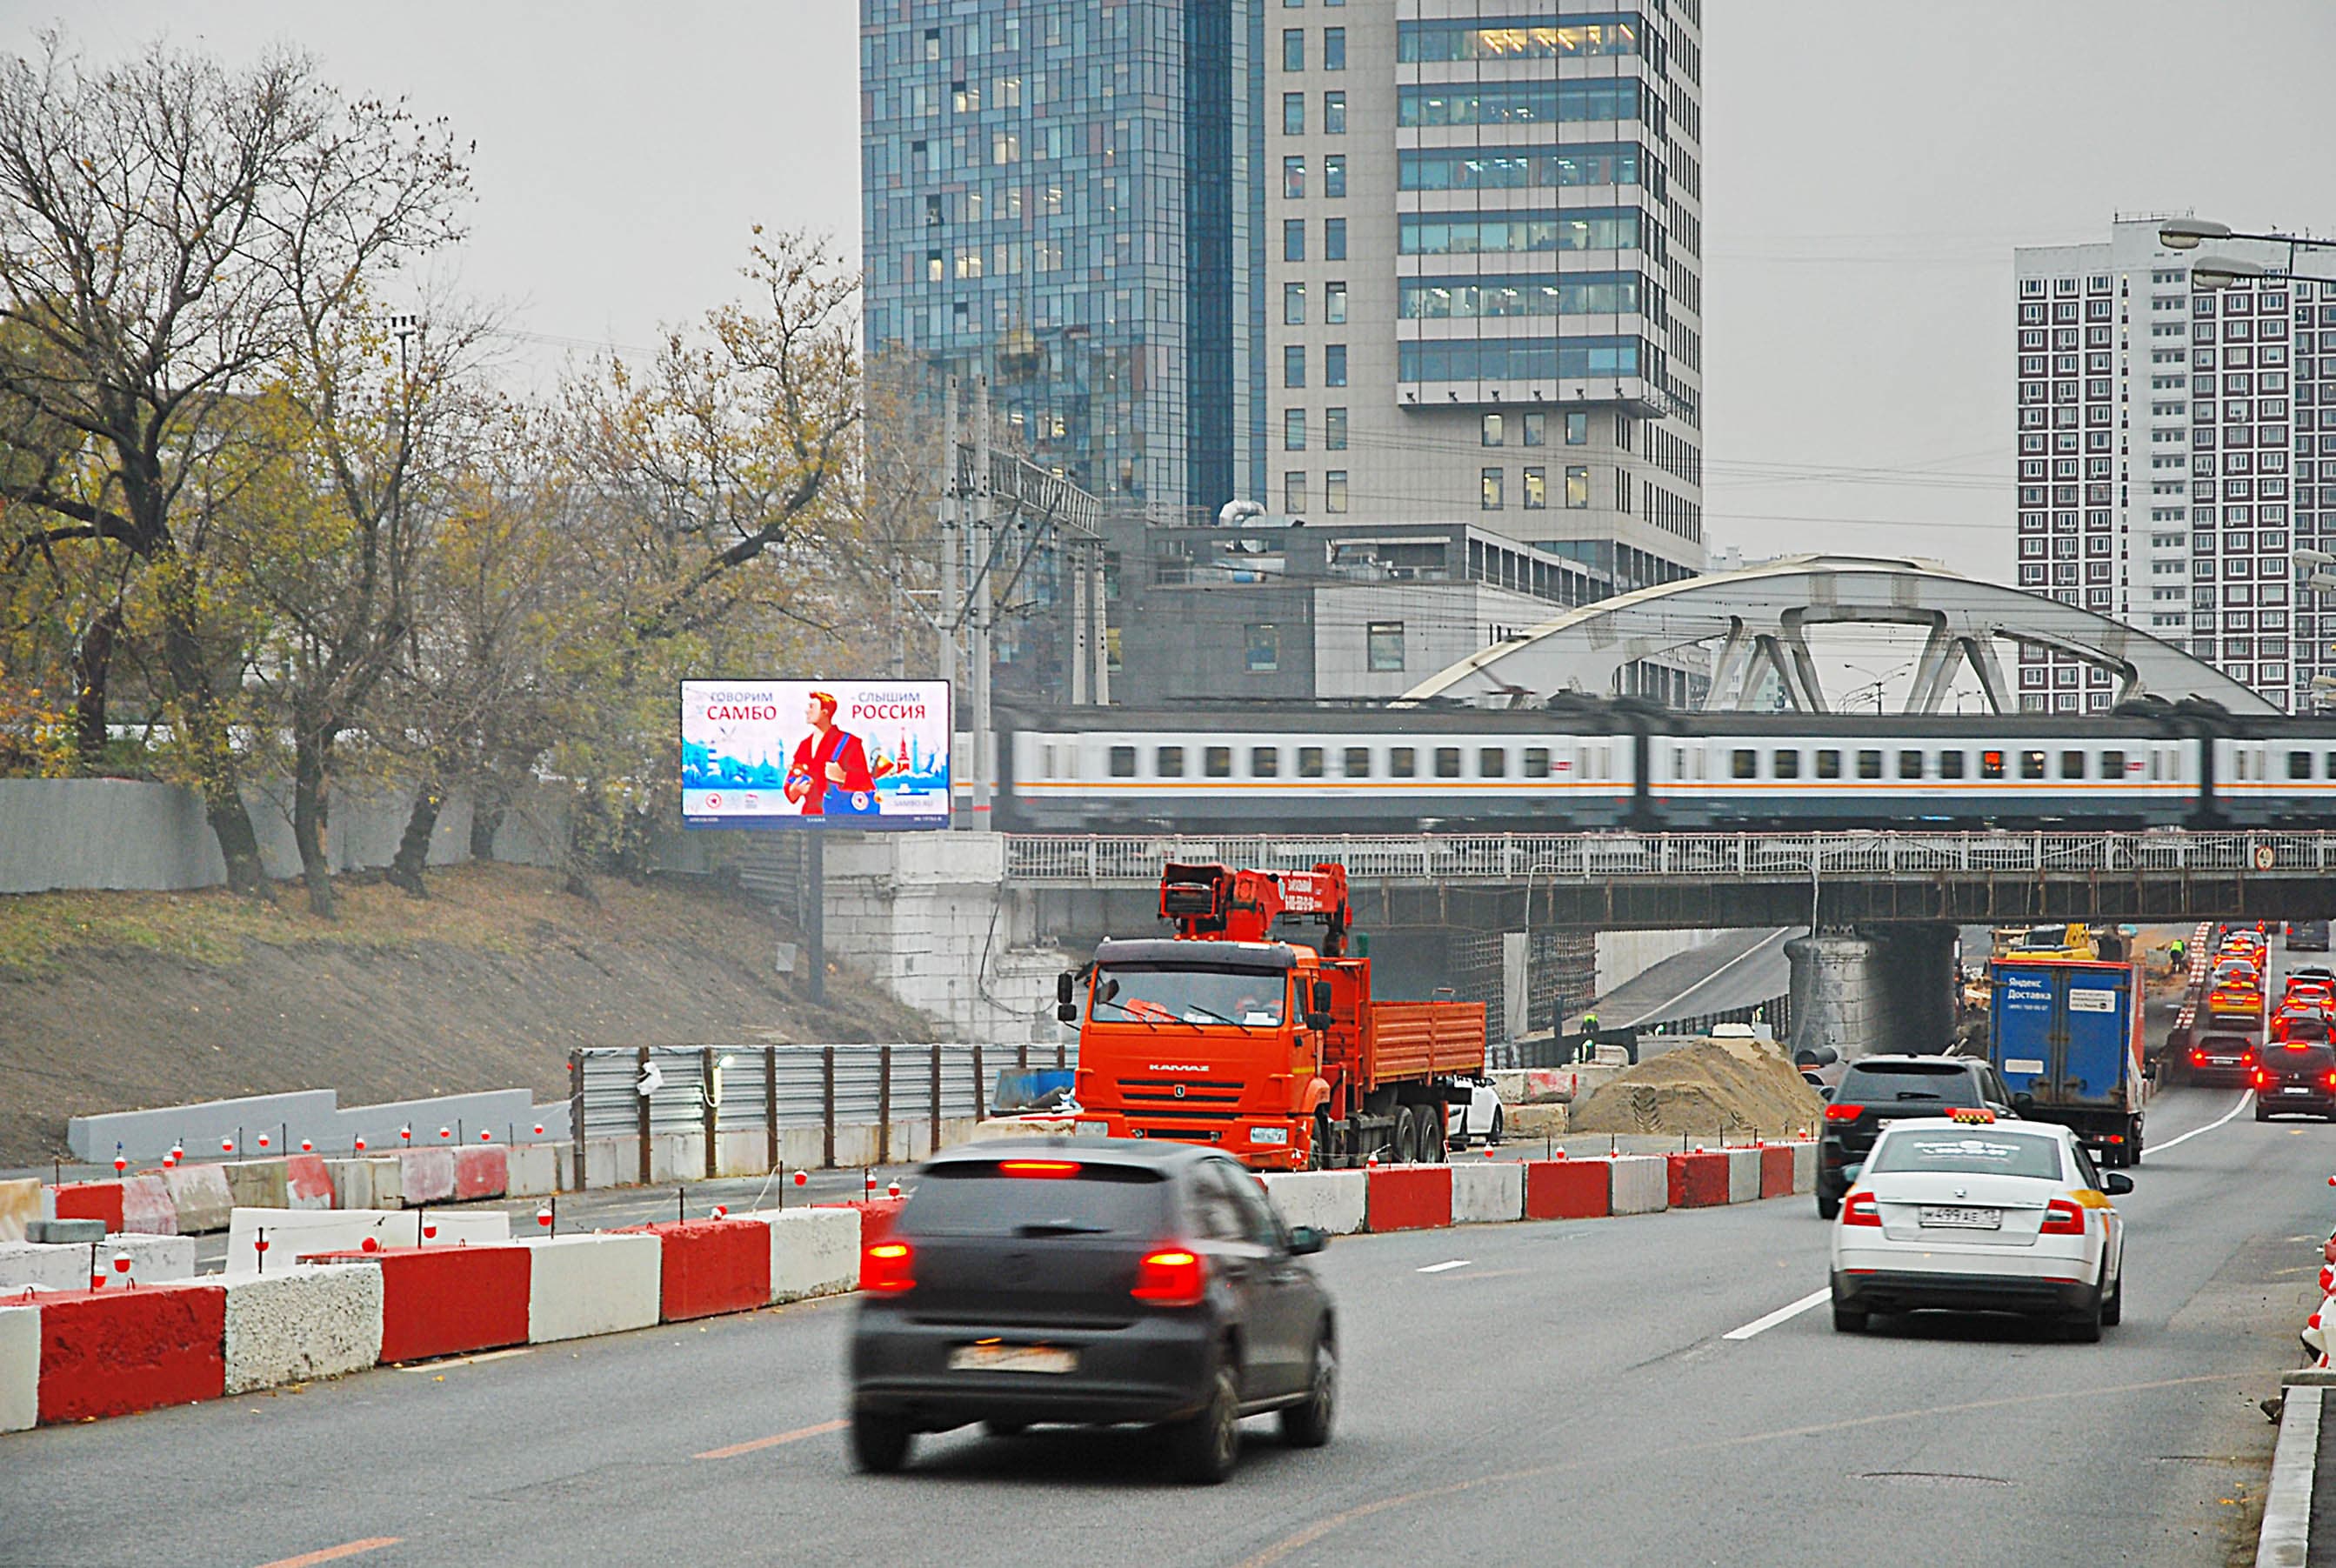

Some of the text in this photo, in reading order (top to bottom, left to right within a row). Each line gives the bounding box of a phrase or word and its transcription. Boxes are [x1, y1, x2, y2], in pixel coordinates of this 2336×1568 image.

[711, 691, 773, 702] ГОВОРИМ
[858, 691, 920, 703] СЛЫШИМ
[707, 705, 777, 720] САМБО
[852, 704, 925, 719] РОССИЯ
[2008, 977, 2042, 988] Яндекс
[2007, 989, 2052, 1000] Доставка
[1149, 1064, 1210, 1072] KAMAZ
